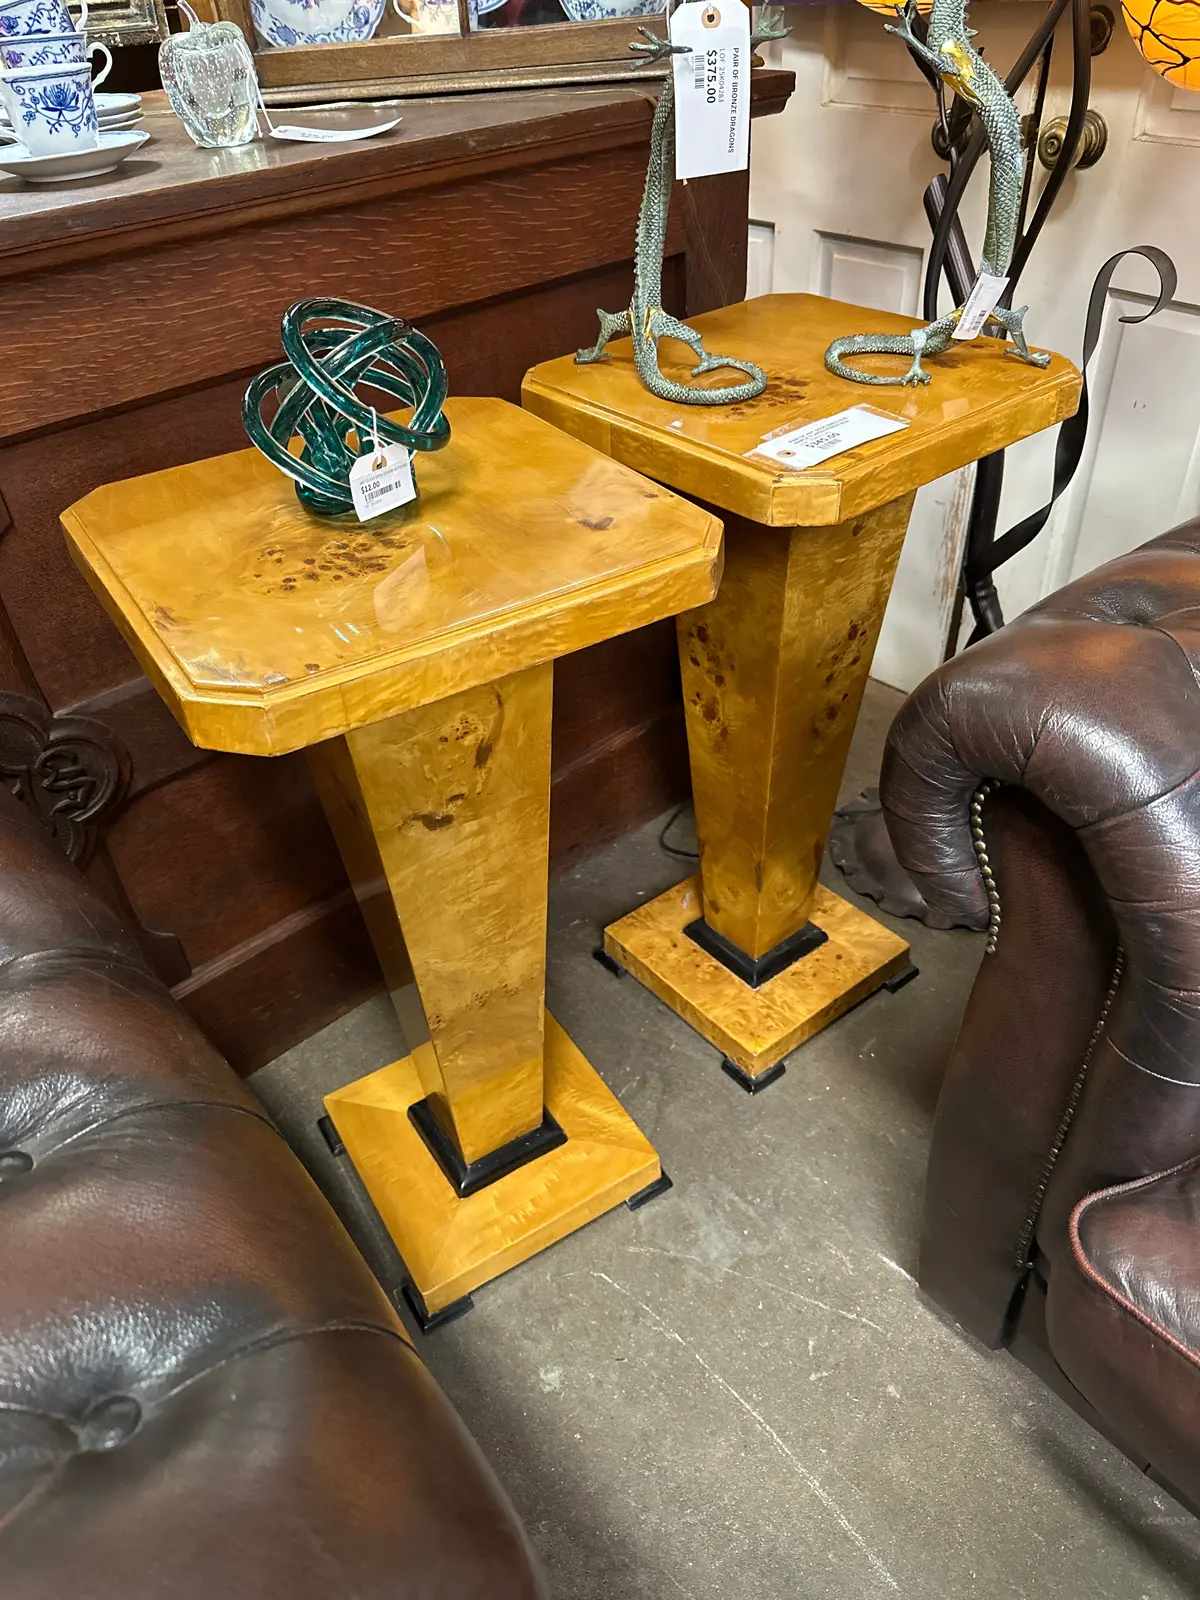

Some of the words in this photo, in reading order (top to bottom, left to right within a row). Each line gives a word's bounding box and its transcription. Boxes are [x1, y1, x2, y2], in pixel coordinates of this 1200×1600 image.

[732, 47, 740, 68] PAIR
[706, 49, 718, 104] $375.00
[732, 69, 739, 80] OF
[731, 82, 739, 114] BRONZE
[728, 116, 737, 153] DRAGONS
[361, 480, 380, 494] $12.00
